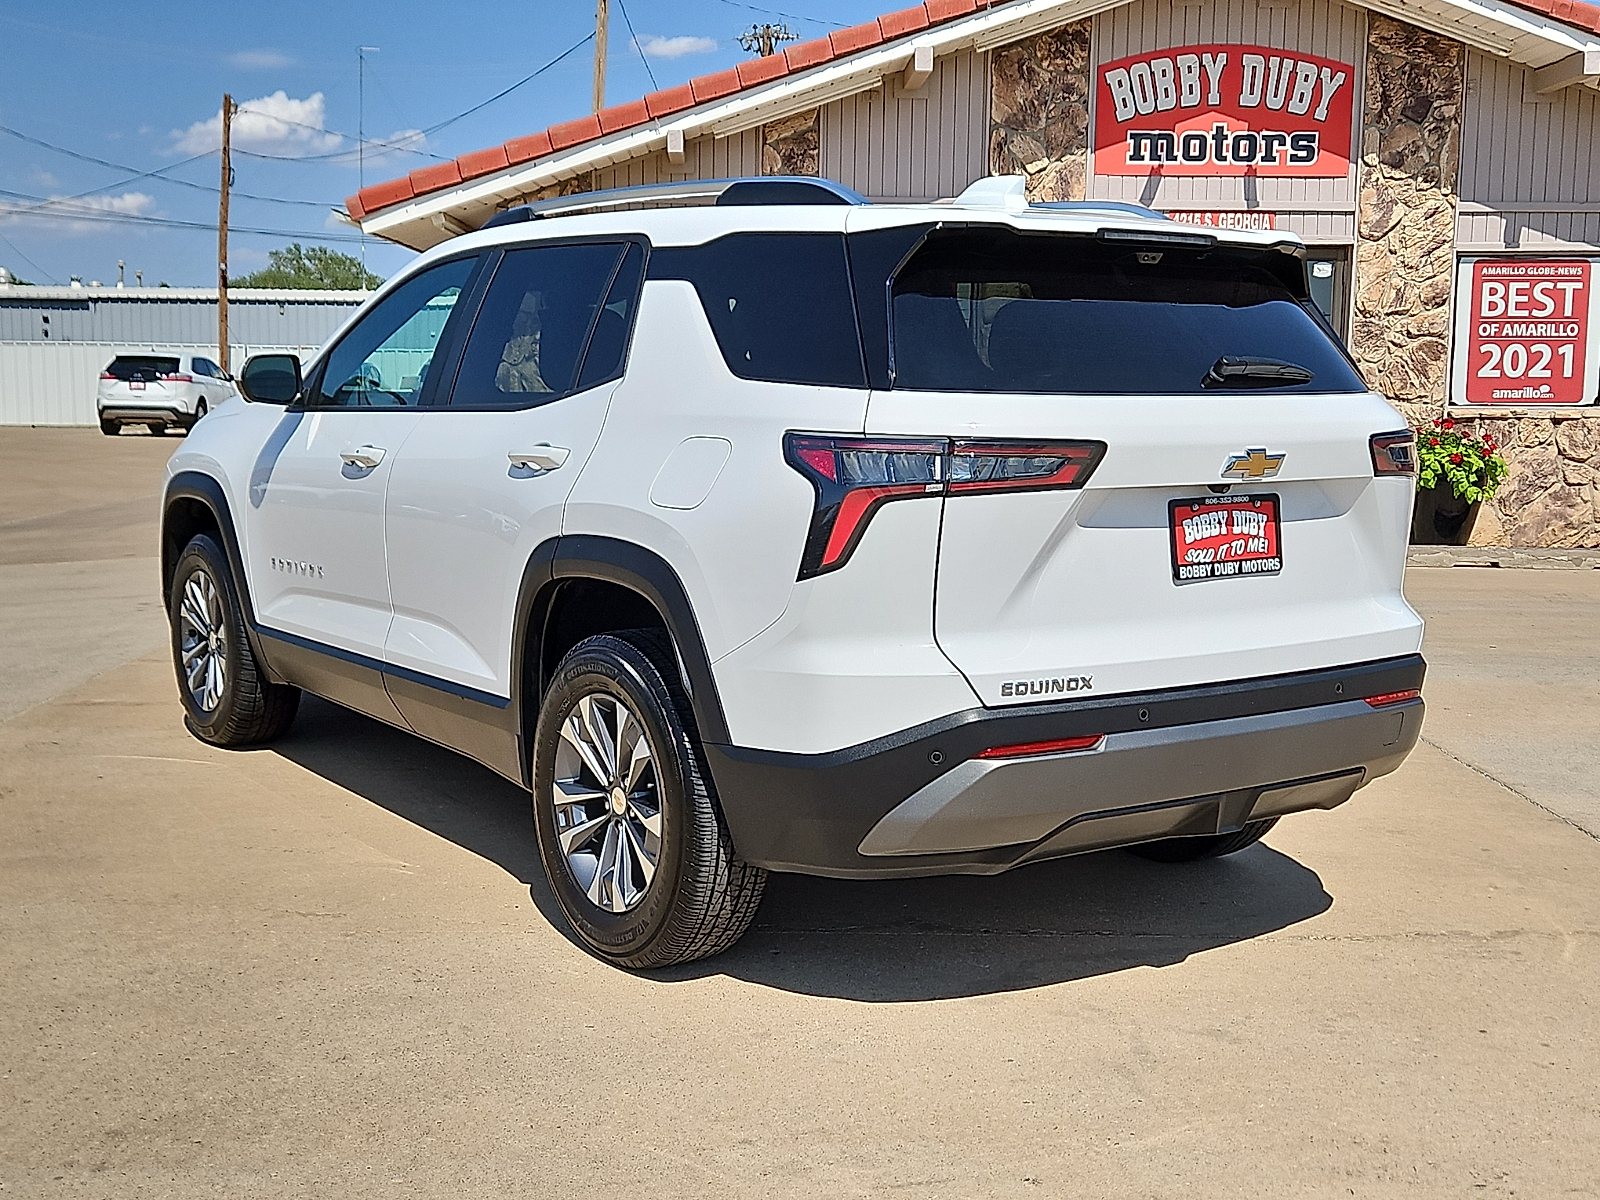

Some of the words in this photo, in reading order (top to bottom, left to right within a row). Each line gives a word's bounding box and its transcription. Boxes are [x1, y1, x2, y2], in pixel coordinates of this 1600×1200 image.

[1104, 52, 1228, 123] BOBBY
[1239, 53, 1347, 122] DUBY
[1127, 124, 1318, 164] motors
[1219, 212, 1271, 230] GEORGIA
[1481, 266, 1526, 275] AMARILLO
[1527, 266, 1583, 275] GLOBE-NEWS
[1480, 281, 1584, 318] BEST
[1478, 323, 1500, 337] OF
[1502, 323, 1579, 337] AMARILLO
[1477, 343, 1575, 378] 2021
[1182, 510, 1228, 545] BOBBY
[1232, 510, 1267, 537] DUBY
[1216, 544, 1230, 560] IT
[1230, 539, 1245, 556] TO
[1180, 564, 1212, 579] BOBBY
[1214, 561, 1240, 576] DUBY
[1242, 558, 1280, 573] MOTORS
[1001, 675, 1093, 697] EQUINOX
